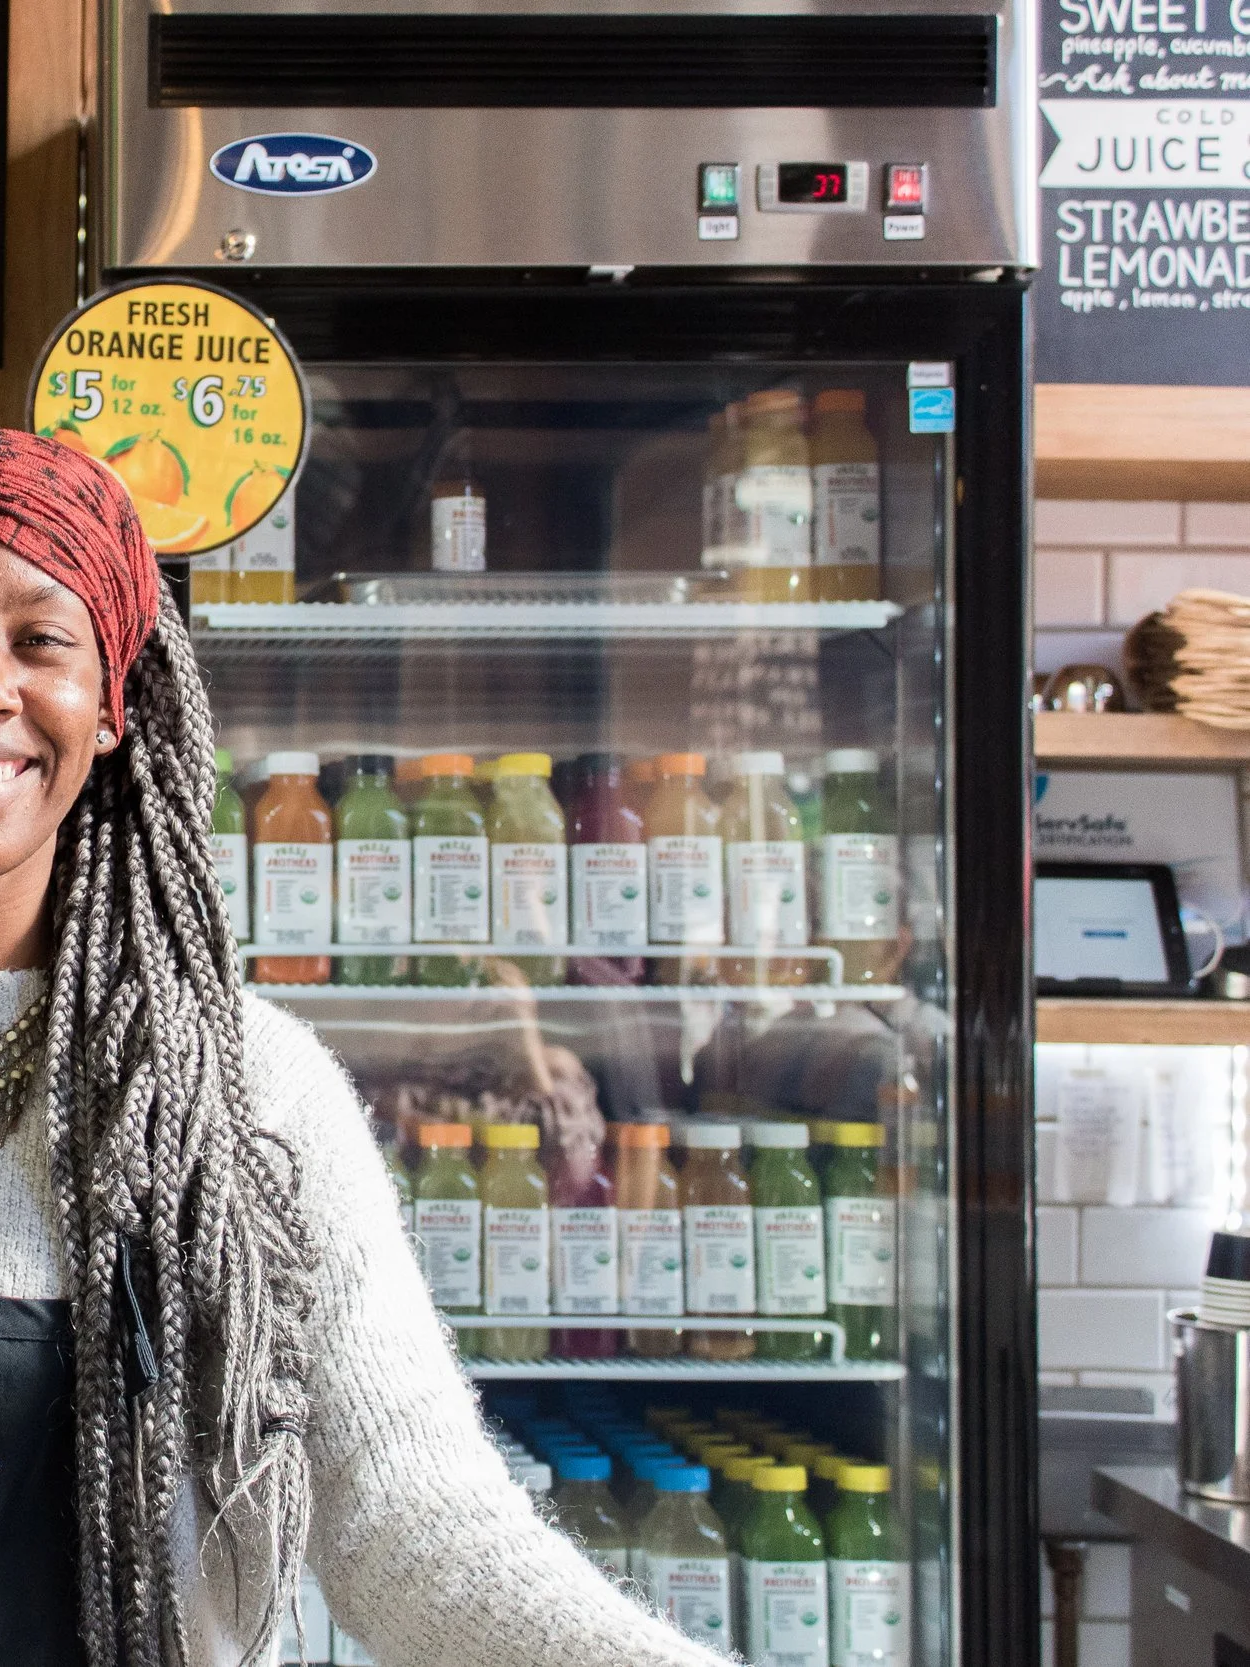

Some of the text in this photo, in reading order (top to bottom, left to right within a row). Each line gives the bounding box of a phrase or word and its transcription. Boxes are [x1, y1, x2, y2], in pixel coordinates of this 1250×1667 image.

[1059, 0, 1207, 33] SWEET
[1061, 35, 1167, 64] pineapple,
[1139, 64, 1216, 91] about
[1156, 108, 1235, 126] COLD
[1076, 136, 1220, 173] JUICE
[1056, 199, 1250, 243] STRAWBE
[127, 300, 210, 327] FRESH
[66, 329, 271, 364] ORANGE JUICE
[48, 369, 136, 421] $5 for
[112, 399, 132, 415] 12
[232, 404, 257, 421] for
[233, 428, 254, 444] 16
